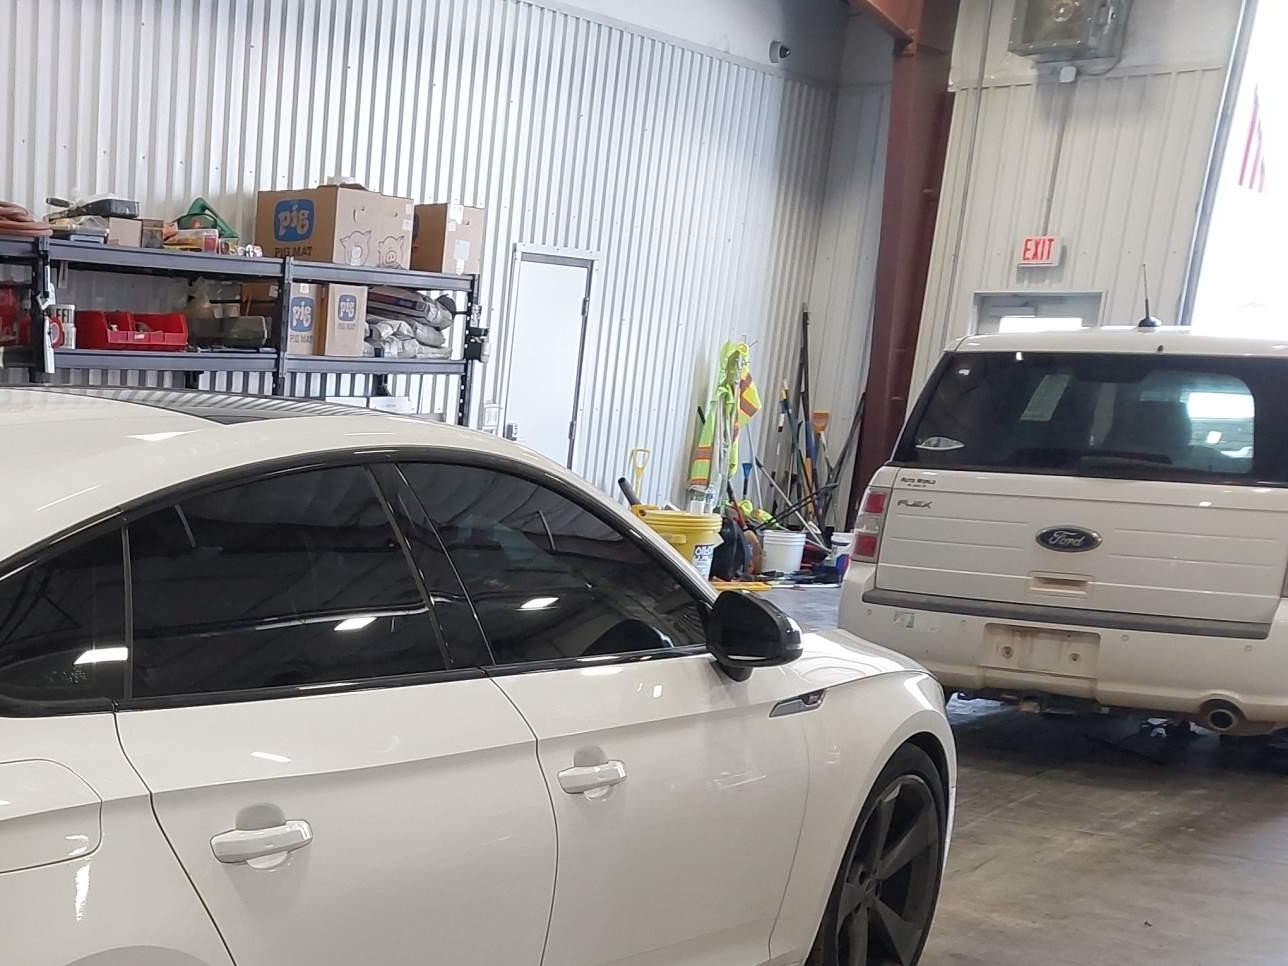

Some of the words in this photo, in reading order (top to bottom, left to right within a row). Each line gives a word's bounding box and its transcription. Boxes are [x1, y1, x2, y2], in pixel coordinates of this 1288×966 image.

[278, 204, 310, 236] pig
[275, 247, 290, 258] PIG
[292, 246, 313, 257] MAT
[1022, 238, 1054, 261] EXIT
[292, 301, 312, 328] pig
[339, 298, 355, 318] pig
[1048, 530, 1086, 547] Ford
